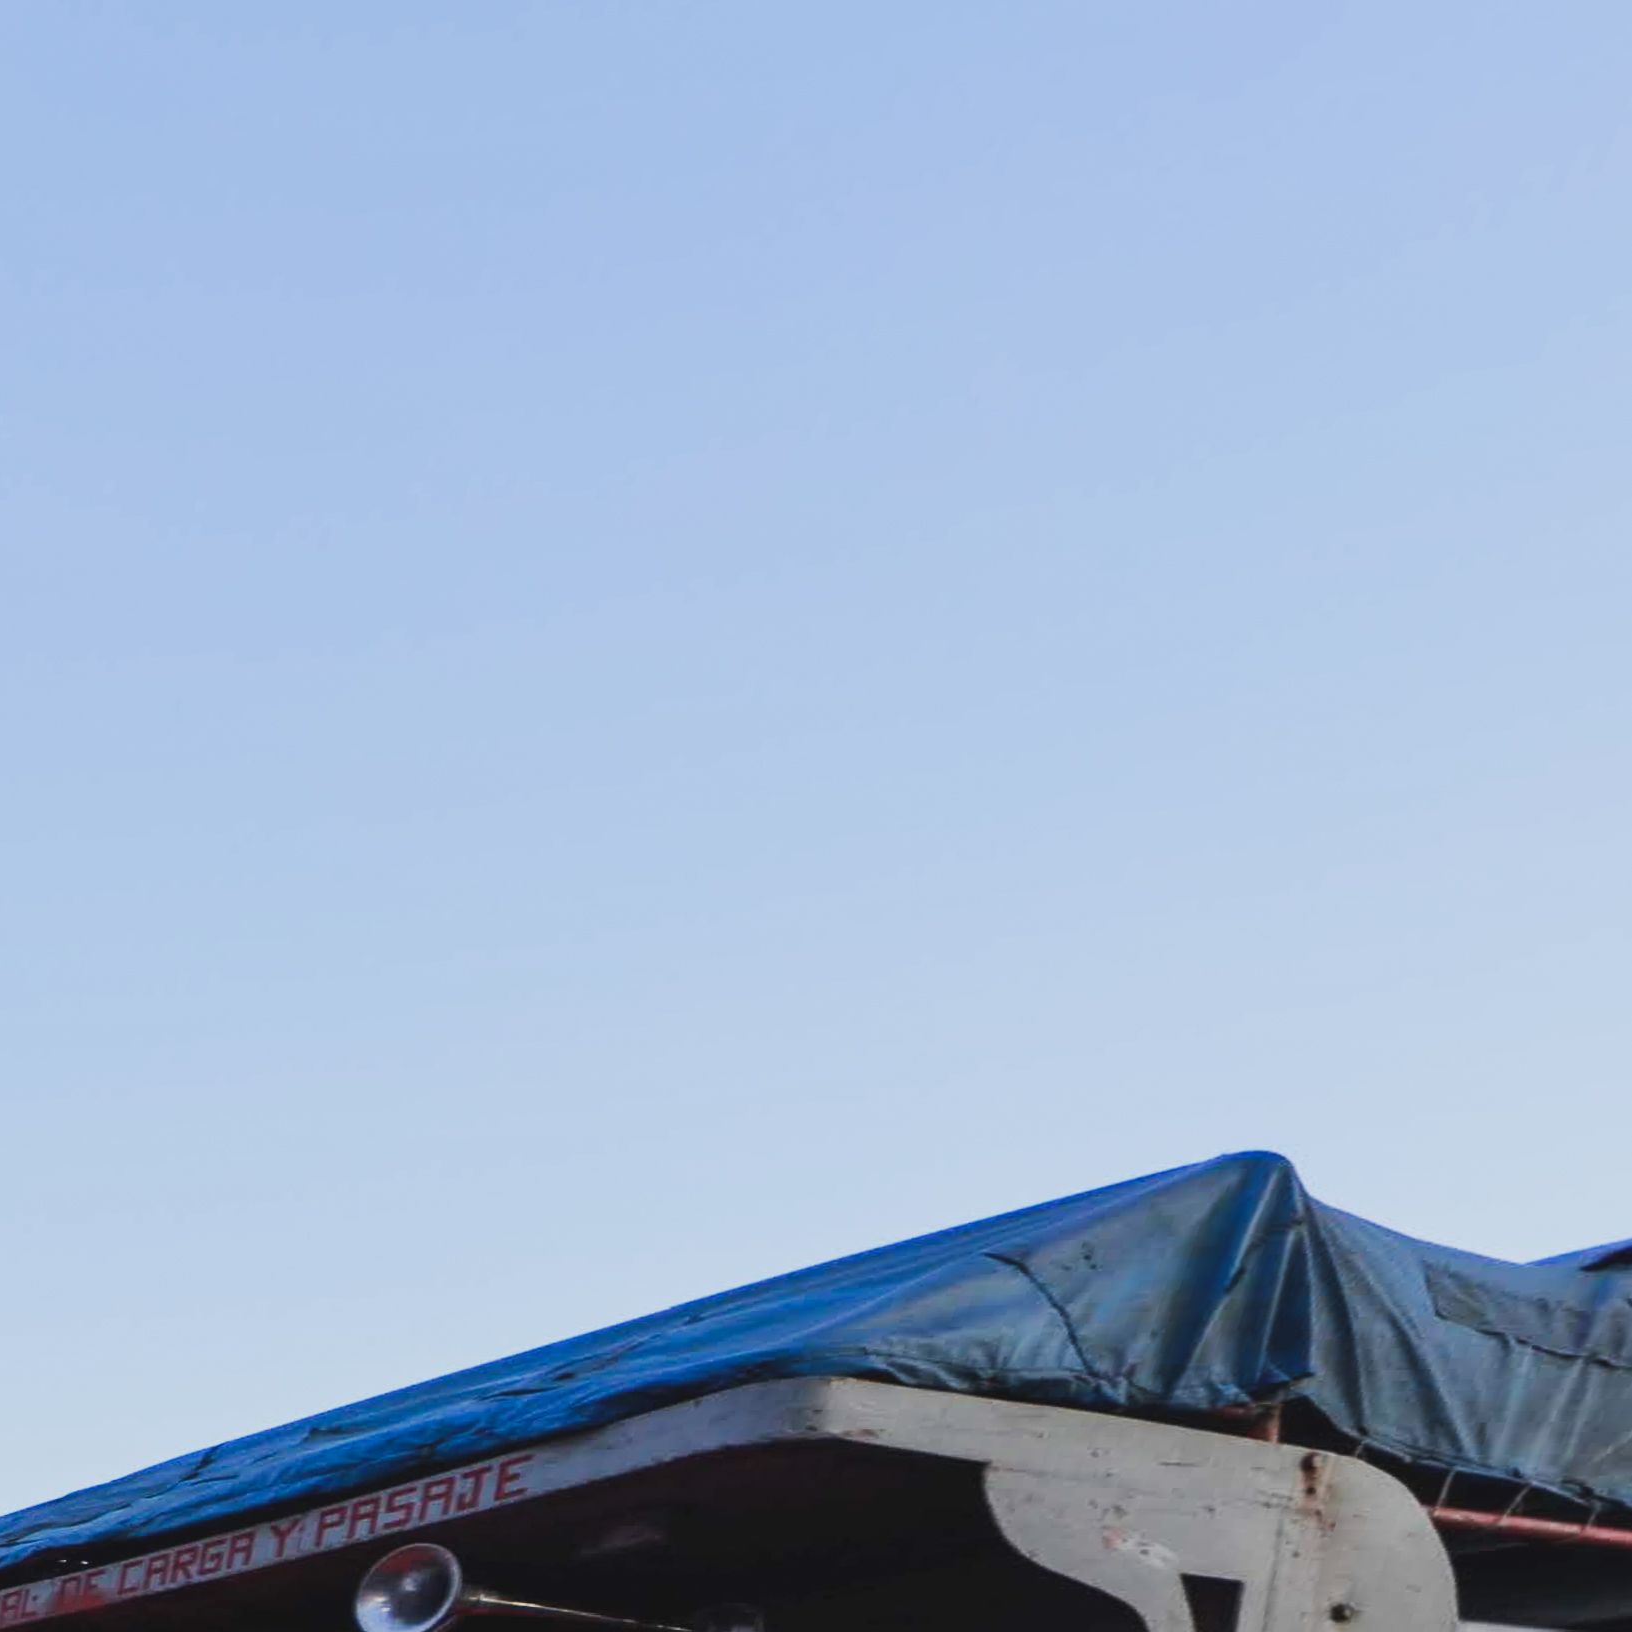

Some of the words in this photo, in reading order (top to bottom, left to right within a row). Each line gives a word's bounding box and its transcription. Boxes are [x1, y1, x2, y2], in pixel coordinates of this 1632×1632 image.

[116, 1532, 254, 1595] CARGA
[270, 1519, 299, 1558] Y
[314, 1453, 533, 1548] PASAJE
